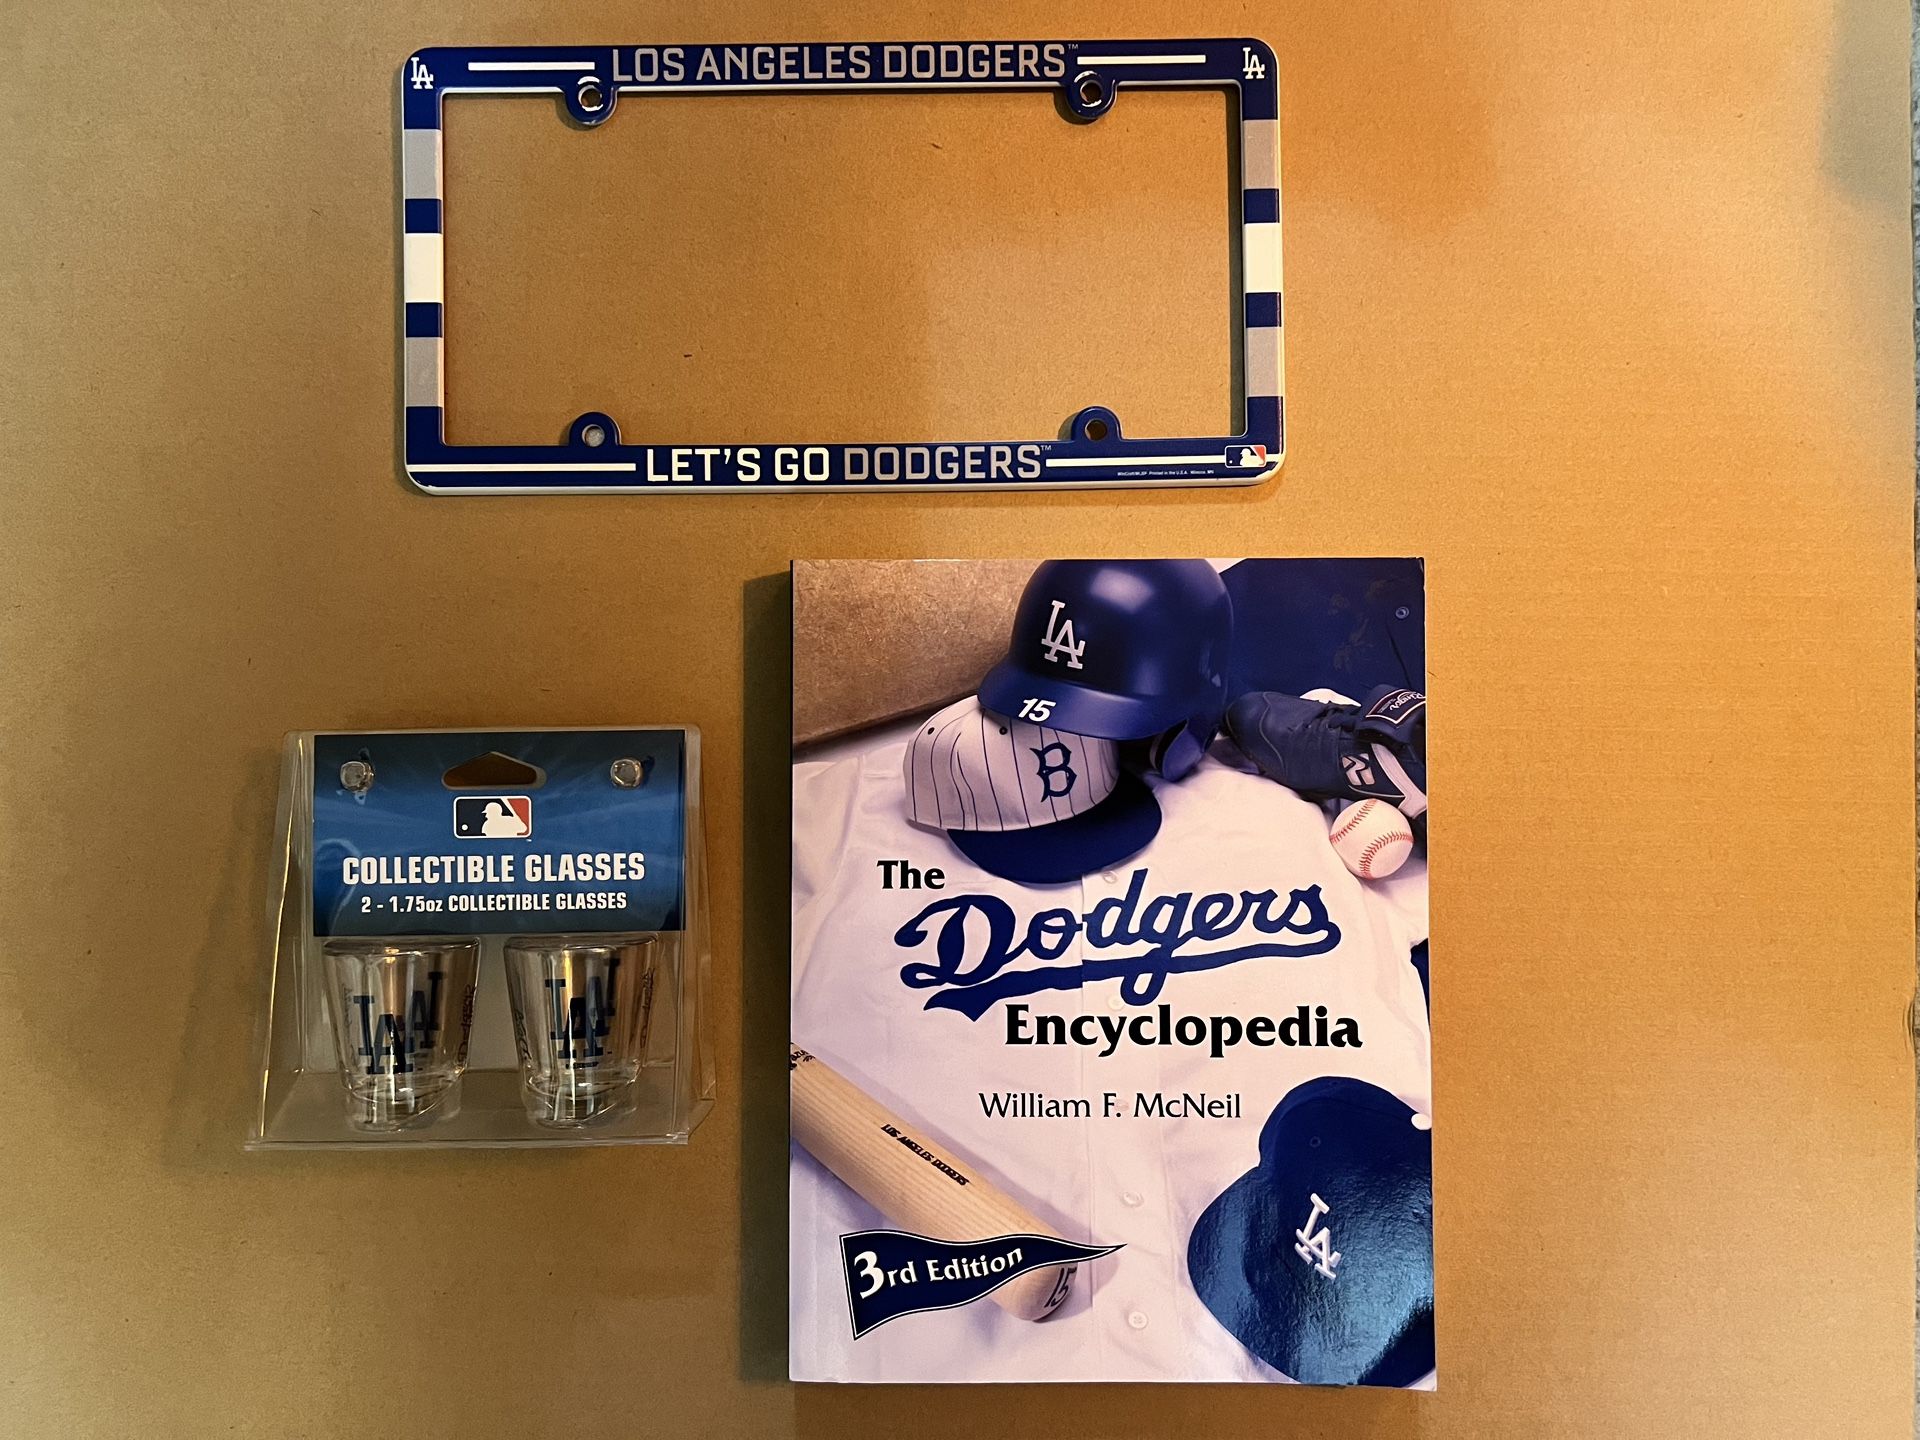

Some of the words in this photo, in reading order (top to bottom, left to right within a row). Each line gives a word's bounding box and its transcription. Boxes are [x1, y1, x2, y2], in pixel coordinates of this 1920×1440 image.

[410, 56, 434, 90] LA
[612, 47, 685, 82] LOS
[695, 44, 871, 81] ANGELES
[1242, 46, 1266, 80] LA
[646, 447, 761, 482] LET'S
[774, 446, 830, 482] GO
[1041, 600, 1086, 670] LA
[1018, 698, 1057, 722] 15
[1030, 742, 1077, 803] B
[342, 855, 515, 885] COLLECTIBLE
[525, 852, 646, 883] GLASSES
[876, 860, 946, 890] The
[361, 896, 371, 913] 2
[389, 895, 443, 913] 1.75oz
[448, 893, 550, 912] COLLECTIBLE
[556, 891, 627, 910] GLASSES
[894, 868, 1342, 1022] Dodgers
[353, 995, 416, 1075] LA
[1005, 1003, 1364, 1058] Encyclopedia
[978, 1091, 1092, 1119] William
[1102, 1092, 1122, 1119] F.
[1133, 1091, 1242, 1119] McNeil
[881, 1123, 902, 1138] LOS
[896, 1136, 935, 1162] ANGELES
[1294, 1192, 1342, 1281] LA
[853, 1250, 918, 1300] 3rd
[925, 1247, 1024, 1282] Edition
[1043, 1266, 1078, 1309] 15
